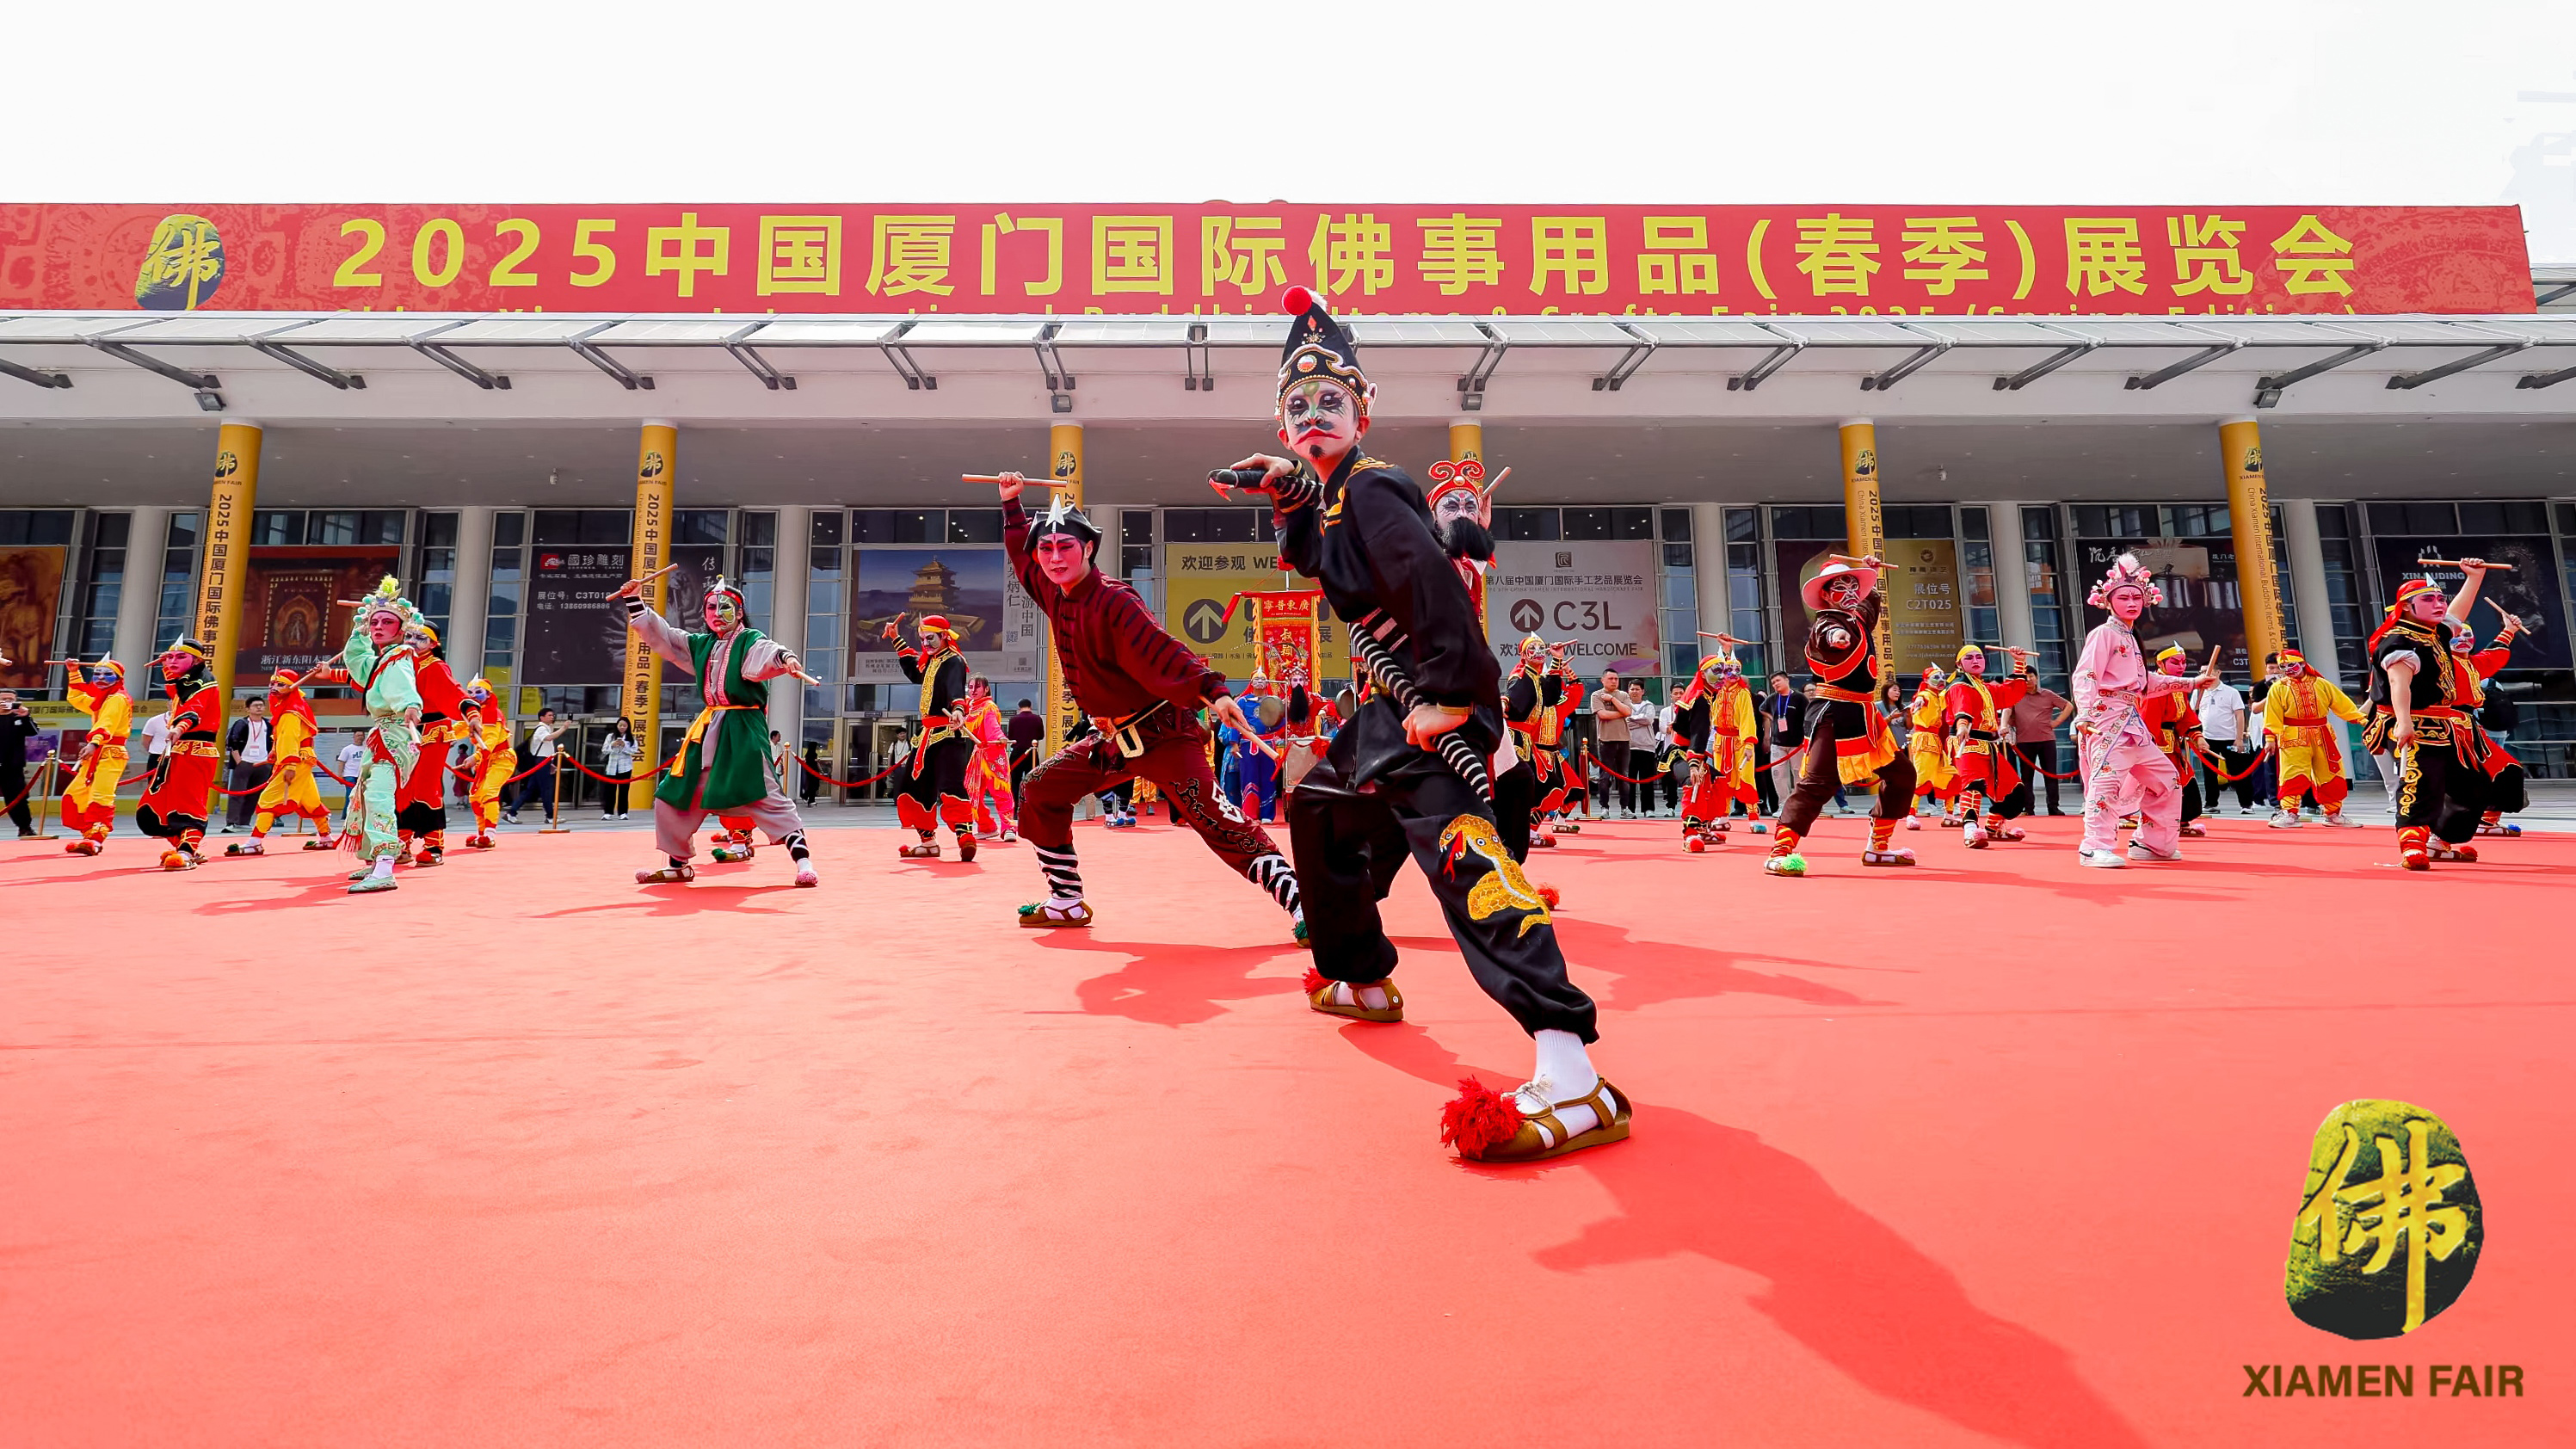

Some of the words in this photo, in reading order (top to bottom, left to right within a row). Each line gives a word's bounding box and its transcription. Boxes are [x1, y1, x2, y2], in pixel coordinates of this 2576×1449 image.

[332, 213, 2355, 299] 2025中国厦门国际佛事用品(春季)展览会
[2247, 487, 2256, 506] China
[2251, 507, 2260, 533] Xiamen
[1181, 555, 1246, 571] 欢迎参观
[2254, 534, 2266, 578] International
[1485, 575, 1643, 586] 第八届中国厦门国际手工艺品展览会
[1914, 583, 1950, 595] 展位号
[2261, 579, 2272, 609] Buddhist
[1906, 599, 1952, 610] C2T025
[1553, 601, 1623, 631] C3L
[1563, 643, 1638, 656] WELCOME
